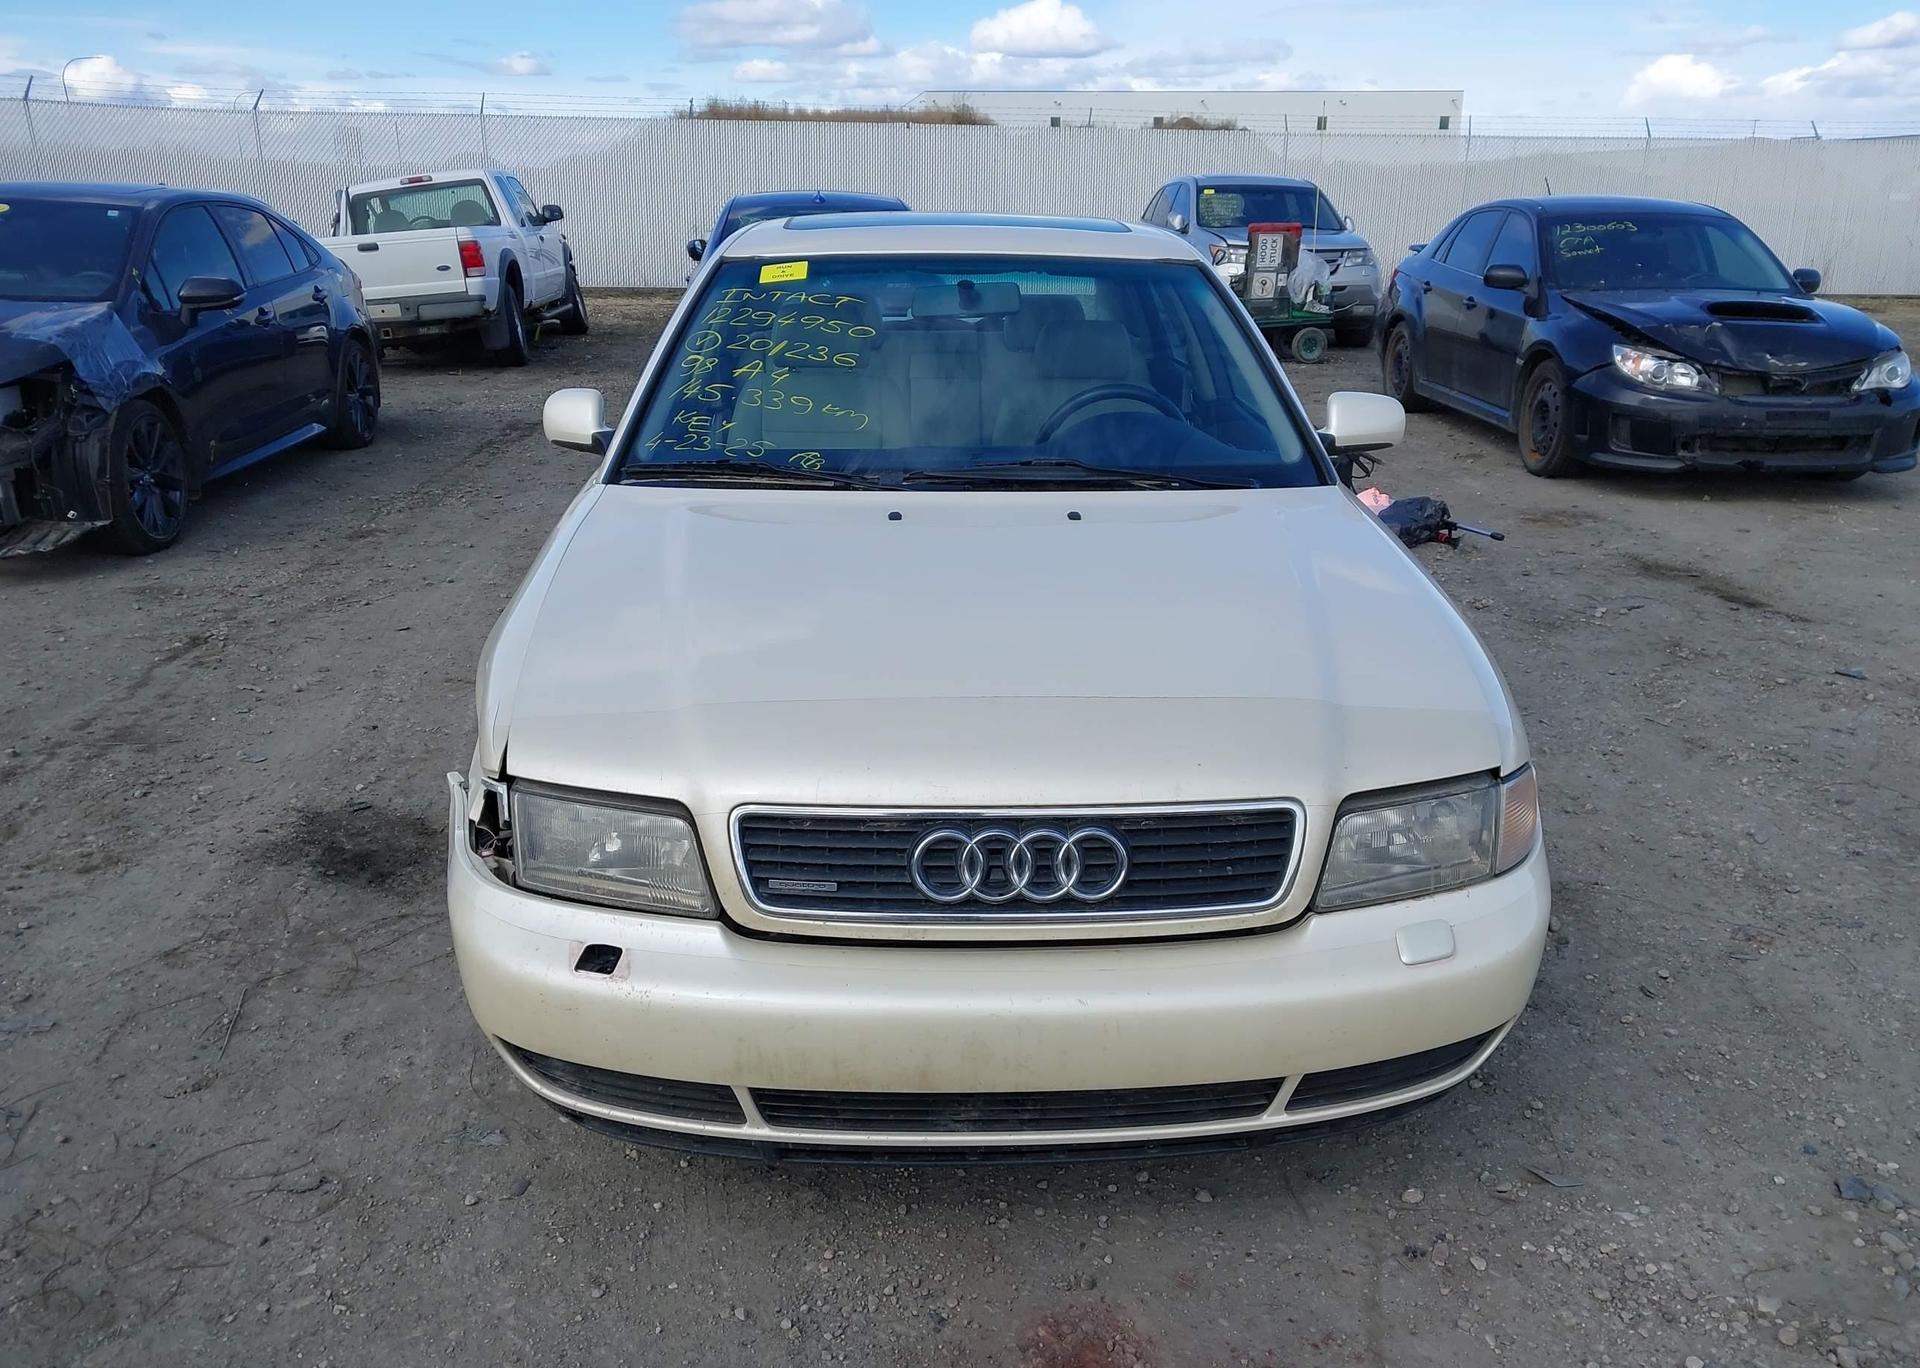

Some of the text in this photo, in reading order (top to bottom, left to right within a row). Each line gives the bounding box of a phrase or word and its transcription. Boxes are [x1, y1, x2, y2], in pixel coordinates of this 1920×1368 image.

[1260, 238, 1268, 263] HOOD
[1269, 238, 1278, 264] STUCK
[717, 288, 867, 309] INTACT
[701, 307, 876, 338] 12294950
[726, 334, 858, 369] 201236
[680, 354, 719, 377] 98
